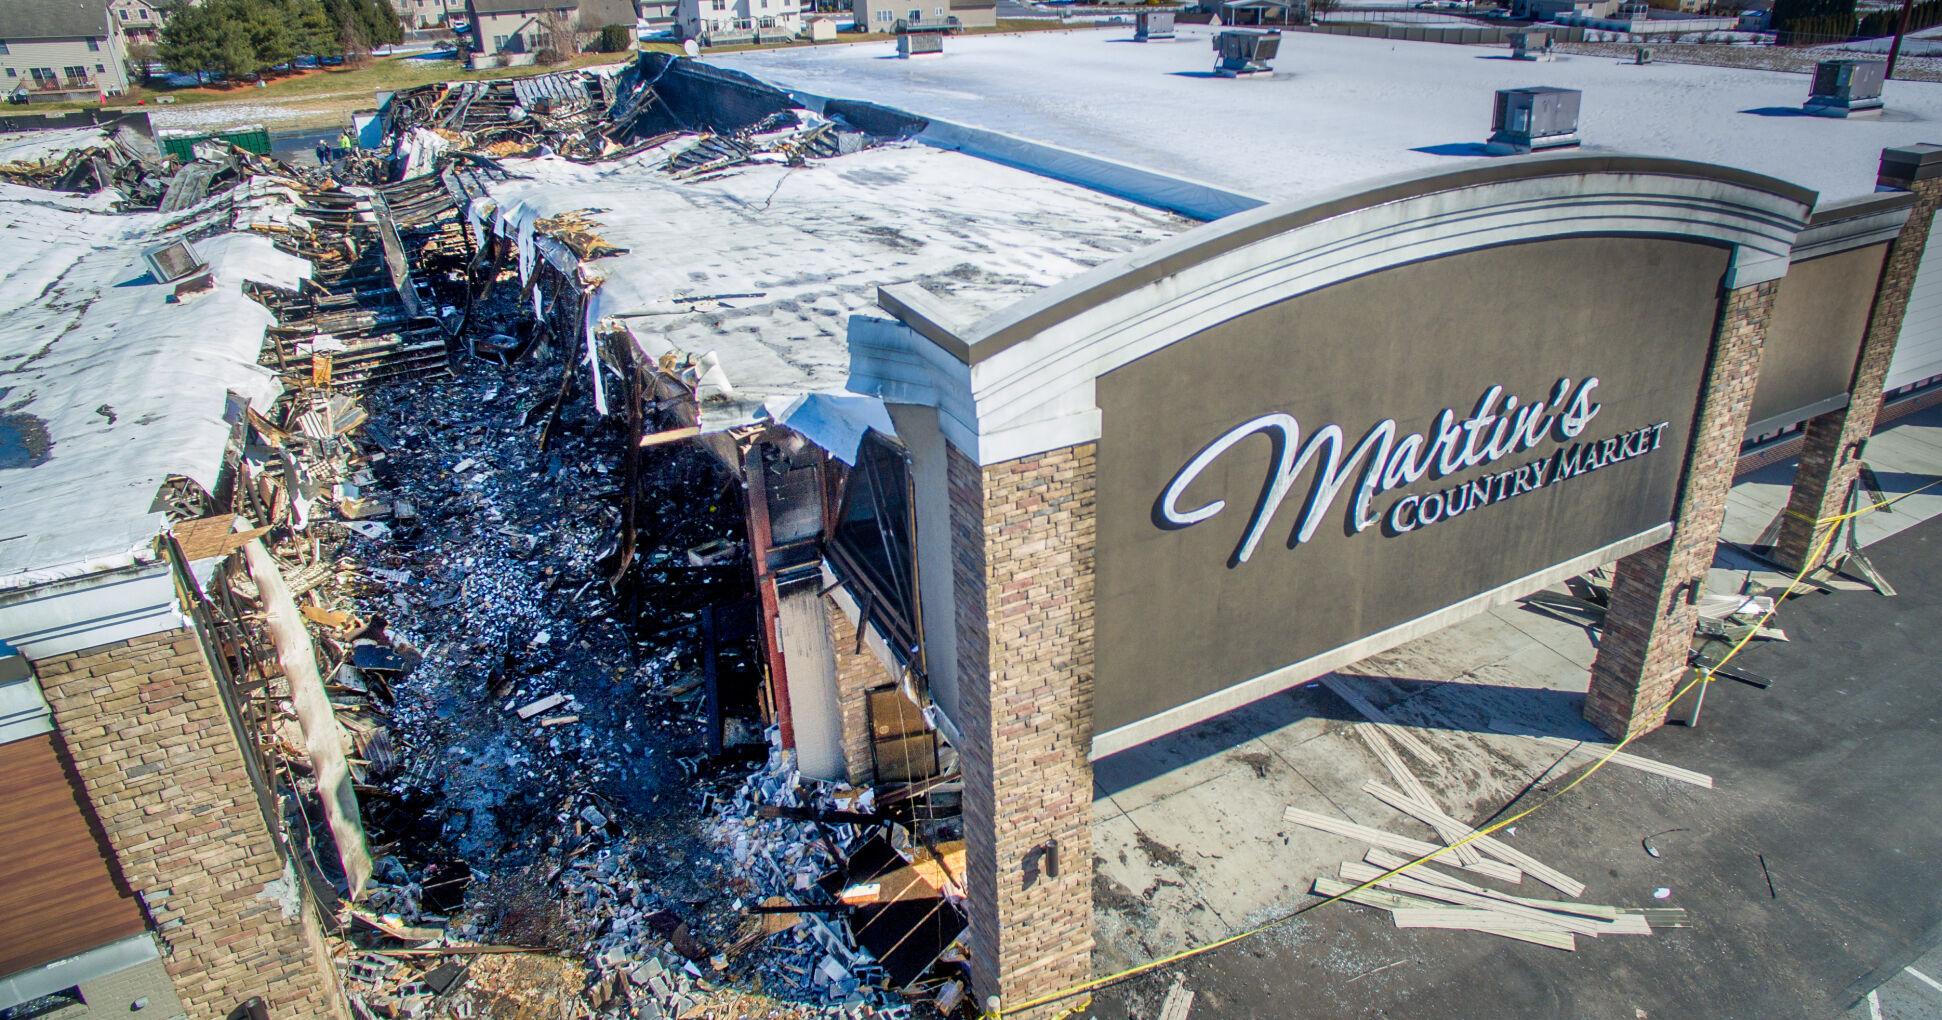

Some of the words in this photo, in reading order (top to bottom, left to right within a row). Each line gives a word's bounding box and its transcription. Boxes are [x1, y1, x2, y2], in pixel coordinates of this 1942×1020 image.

[1164, 376, 1601, 563] Martin's
[1390, 457, 1552, 533] COUNTRY
[1551, 421, 1669, 483] MARKET
